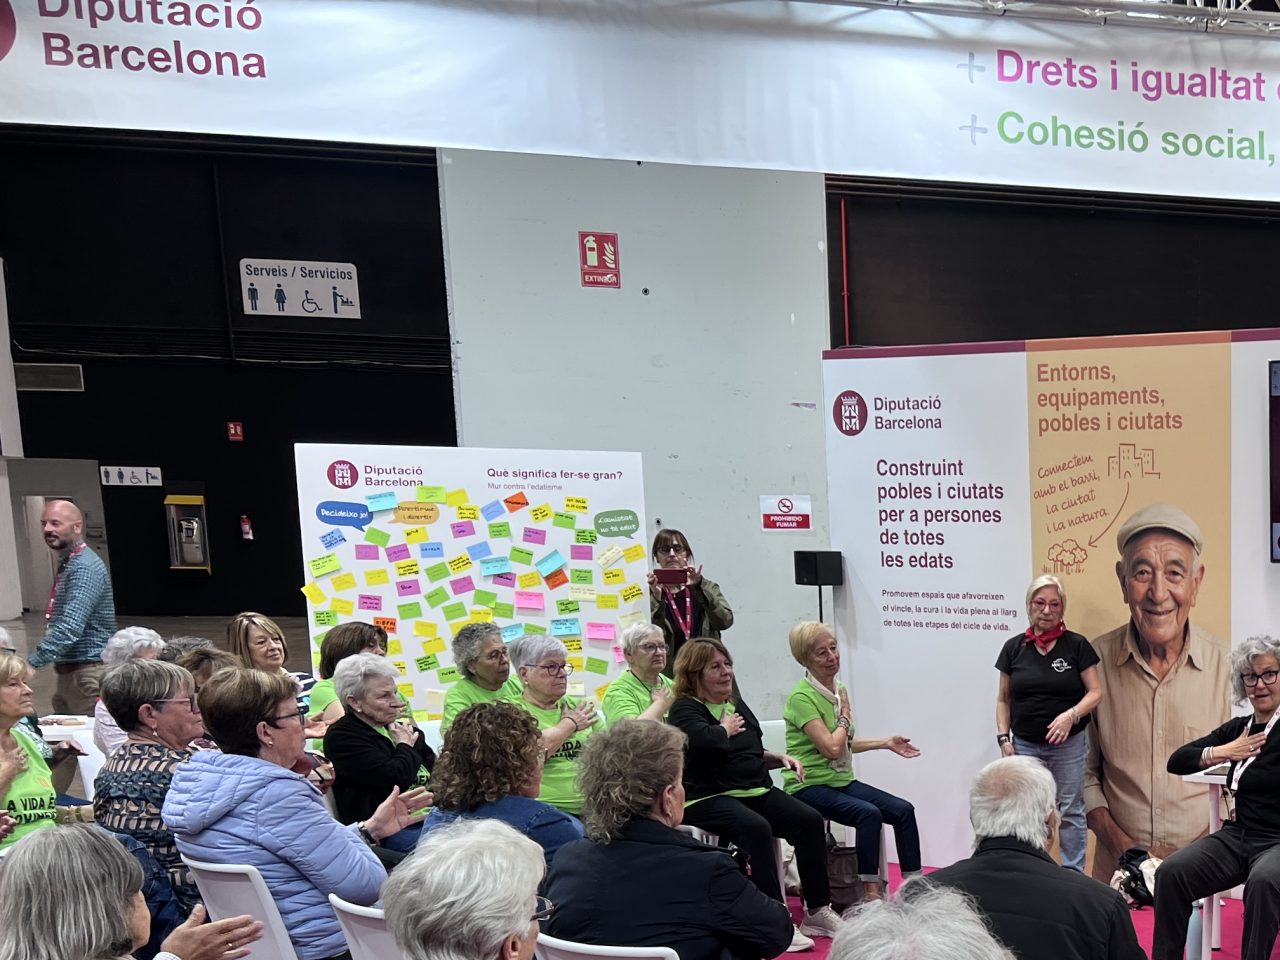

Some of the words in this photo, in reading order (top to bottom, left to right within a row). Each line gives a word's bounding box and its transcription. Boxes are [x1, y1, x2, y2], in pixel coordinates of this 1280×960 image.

[37, 0, 262, 30] Diputació
[42, 32, 267, 78] Barcelona
[996, 49, 1098, 89] Drets
[1110, 60, 1118, 90] i
[1131, 62, 1266, 101] igualtat
[997, 111, 1149, 153] Cohesió
[1161, 129, 1276, 167] social,
[245, 264, 288, 277] Serveis
[300, 266, 352, 280] Servicios
[1037, 363, 1116, 383] Entorns,
[873, 395, 942, 412] Diputació
[1037, 386, 1165, 408] equipaments,
[874, 416, 942, 430] Barcelona
[1038, 412, 1101, 436] pobles
[1106, 412, 1112, 431] i
[1117, 411, 1183, 430] ciutats
[364, 465, 423, 476] Diputació
[487, 468, 509, 478] Què
[512, 469, 557, 480] significa
[560, 470, 590, 479] fer-se
[593, 471, 623, 480] gran?
[876, 459, 964, 476] Construint
[1038, 453, 1094, 479] Connectem
[365, 477, 424, 487] Barcelona
[1034, 484, 1057, 500] amb
[1059, 479, 1068, 494] el
[1070, 470, 1100, 489] barri,
[877, 482, 932, 503] pobles
[937, 483, 942, 498] i
[947, 483, 1004, 500] ciutats
[1046, 502, 1058, 515] la
[1061, 490, 1096, 511] ciutat
[878, 509, 906, 527] per
[909, 511, 919, 522] a
[924, 509, 1002, 526] persones
[1053, 518, 1066, 532] la
[879, 528, 899, 545] de
[904, 529, 945, 545] totes
[881, 551, 904, 568] les
[909, 551, 954, 568] edats
[882, 589, 919, 599] Promovem
[921, 592, 945, 600] espais
[946, 593, 960, 602] que
[962, 592, 1004, 600] afavoreixen
[890, 605, 914, 614] vincle,
[945, 606, 952, 614] la
[953, 606, 968, 615] vida
[970, 607, 990, 617] plena
[1000, 608, 1017, 618] llarg
[894, 620, 912, 628] totes
[913, 620, 923, 628] les
[925, 621, 949, 630] etapes
[963, 622, 980, 630] cicle
[982, 623, 991, 631] de
[993, 622, 1011, 631] vida.
[20, 797, 45, 811] VIDA
